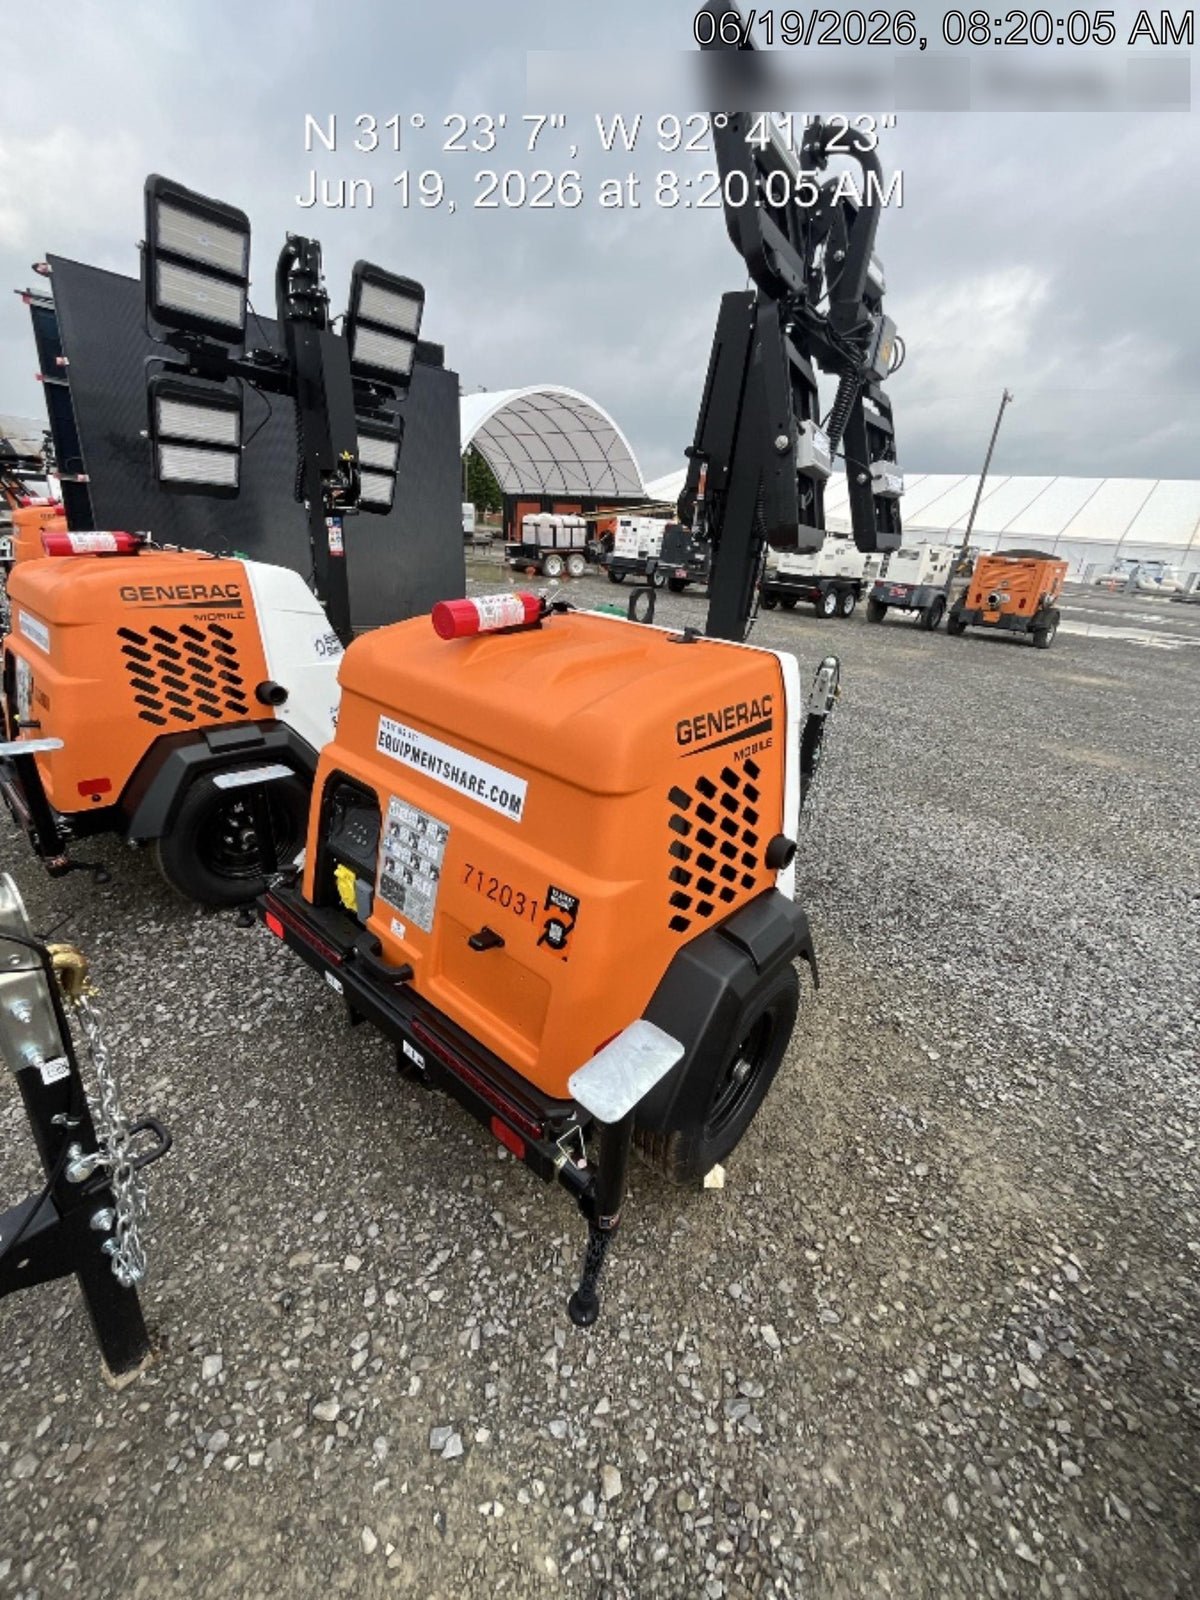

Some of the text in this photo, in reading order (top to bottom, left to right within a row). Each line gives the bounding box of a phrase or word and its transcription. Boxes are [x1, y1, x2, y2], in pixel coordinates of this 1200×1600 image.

[120, 584, 241, 601] GENERAC
[193, 611, 245, 622] MOBILE
[676, 694, 773, 746] GENERAC
[733, 737, 773, 762] MOBILE
[378, 730, 522, 815] EQUIPMENTSHARE.COM
[463, 863, 538, 922] 712031
